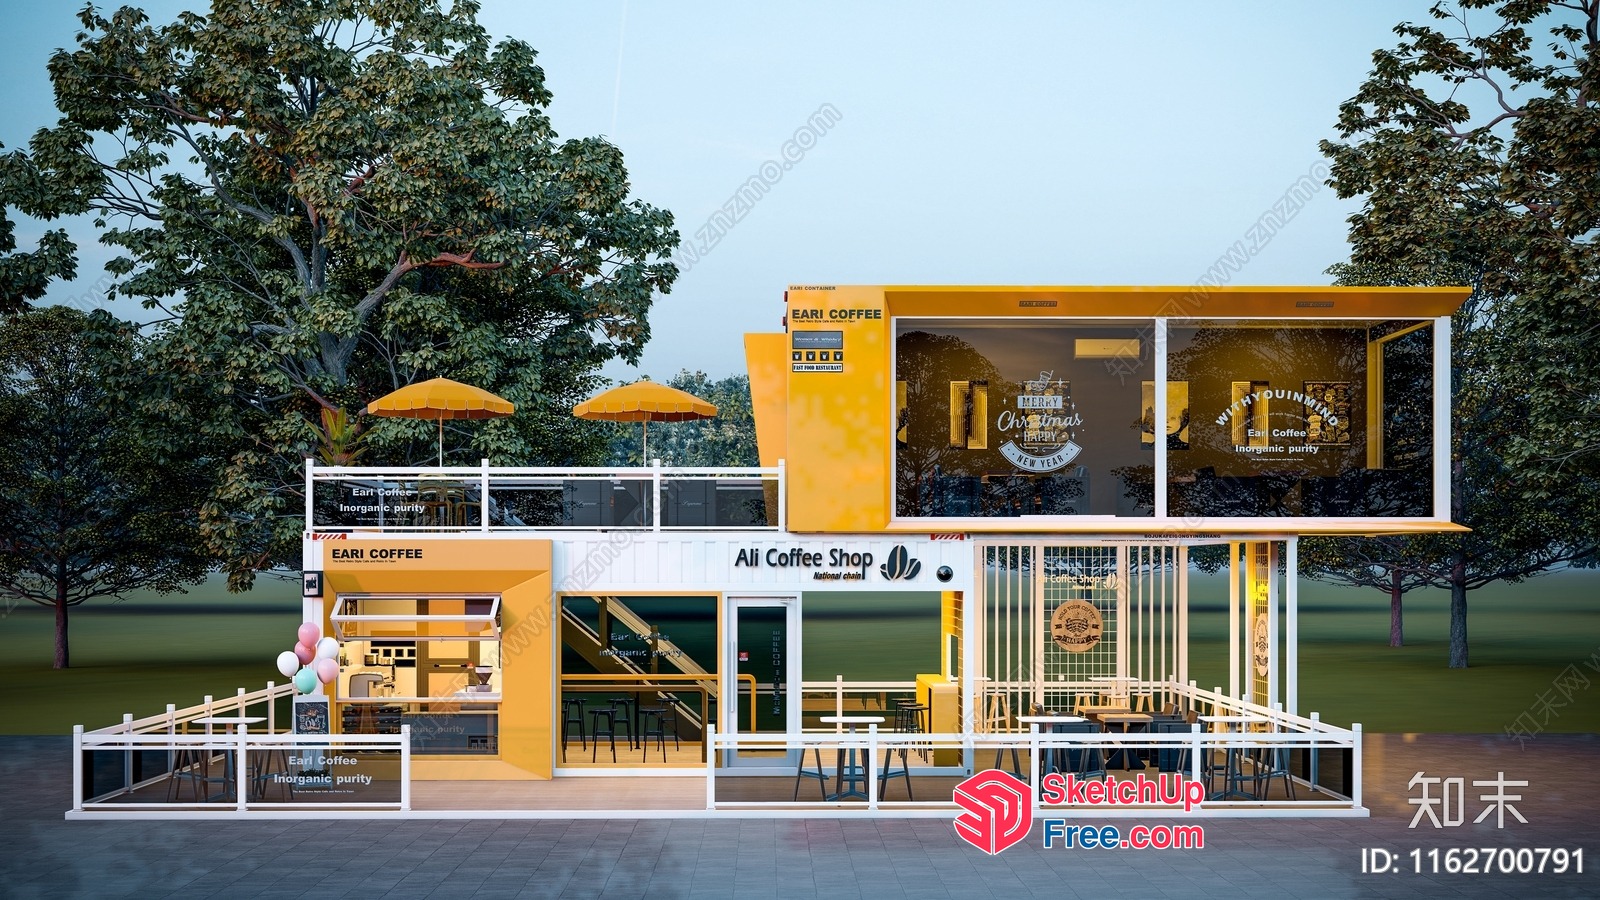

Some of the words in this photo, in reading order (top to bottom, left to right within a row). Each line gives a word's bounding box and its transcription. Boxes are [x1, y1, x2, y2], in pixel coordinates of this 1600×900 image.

[792, 309, 823, 318] EARI
[830, 309, 882, 319] COFFEE
[1022, 397, 1058, 407] MERRY
[1216, 389, 1339, 426] WITHYOUINMIND
[1024, 431, 1057, 442] HAPPY
[1272, 428, 1306, 437] Coffee
[1236, 444, 1284, 454] Inorganic
[1289, 444, 1319, 454] purity
[1016, 454, 1036, 468] NEW
[1040, 454, 1064, 467] YEAR
[340, 504, 390, 513] Inorganic
[394, 504, 425, 513] purity
[332, 549, 364, 558] EARI
[370, 549, 423, 559] COFFEE
[735, 548, 758, 567] Ali
[766, 548, 822, 567] Coffee
[829, 548, 873, 580] Shop
[813, 571, 841, 580] National
[843, 571, 862, 580] chain
[288, 756, 312, 765] Earl
[318, 756, 357, 765] Coffee
[274, 774, 332, 784] Inorganic
[336, 774, 372, 784] purity
